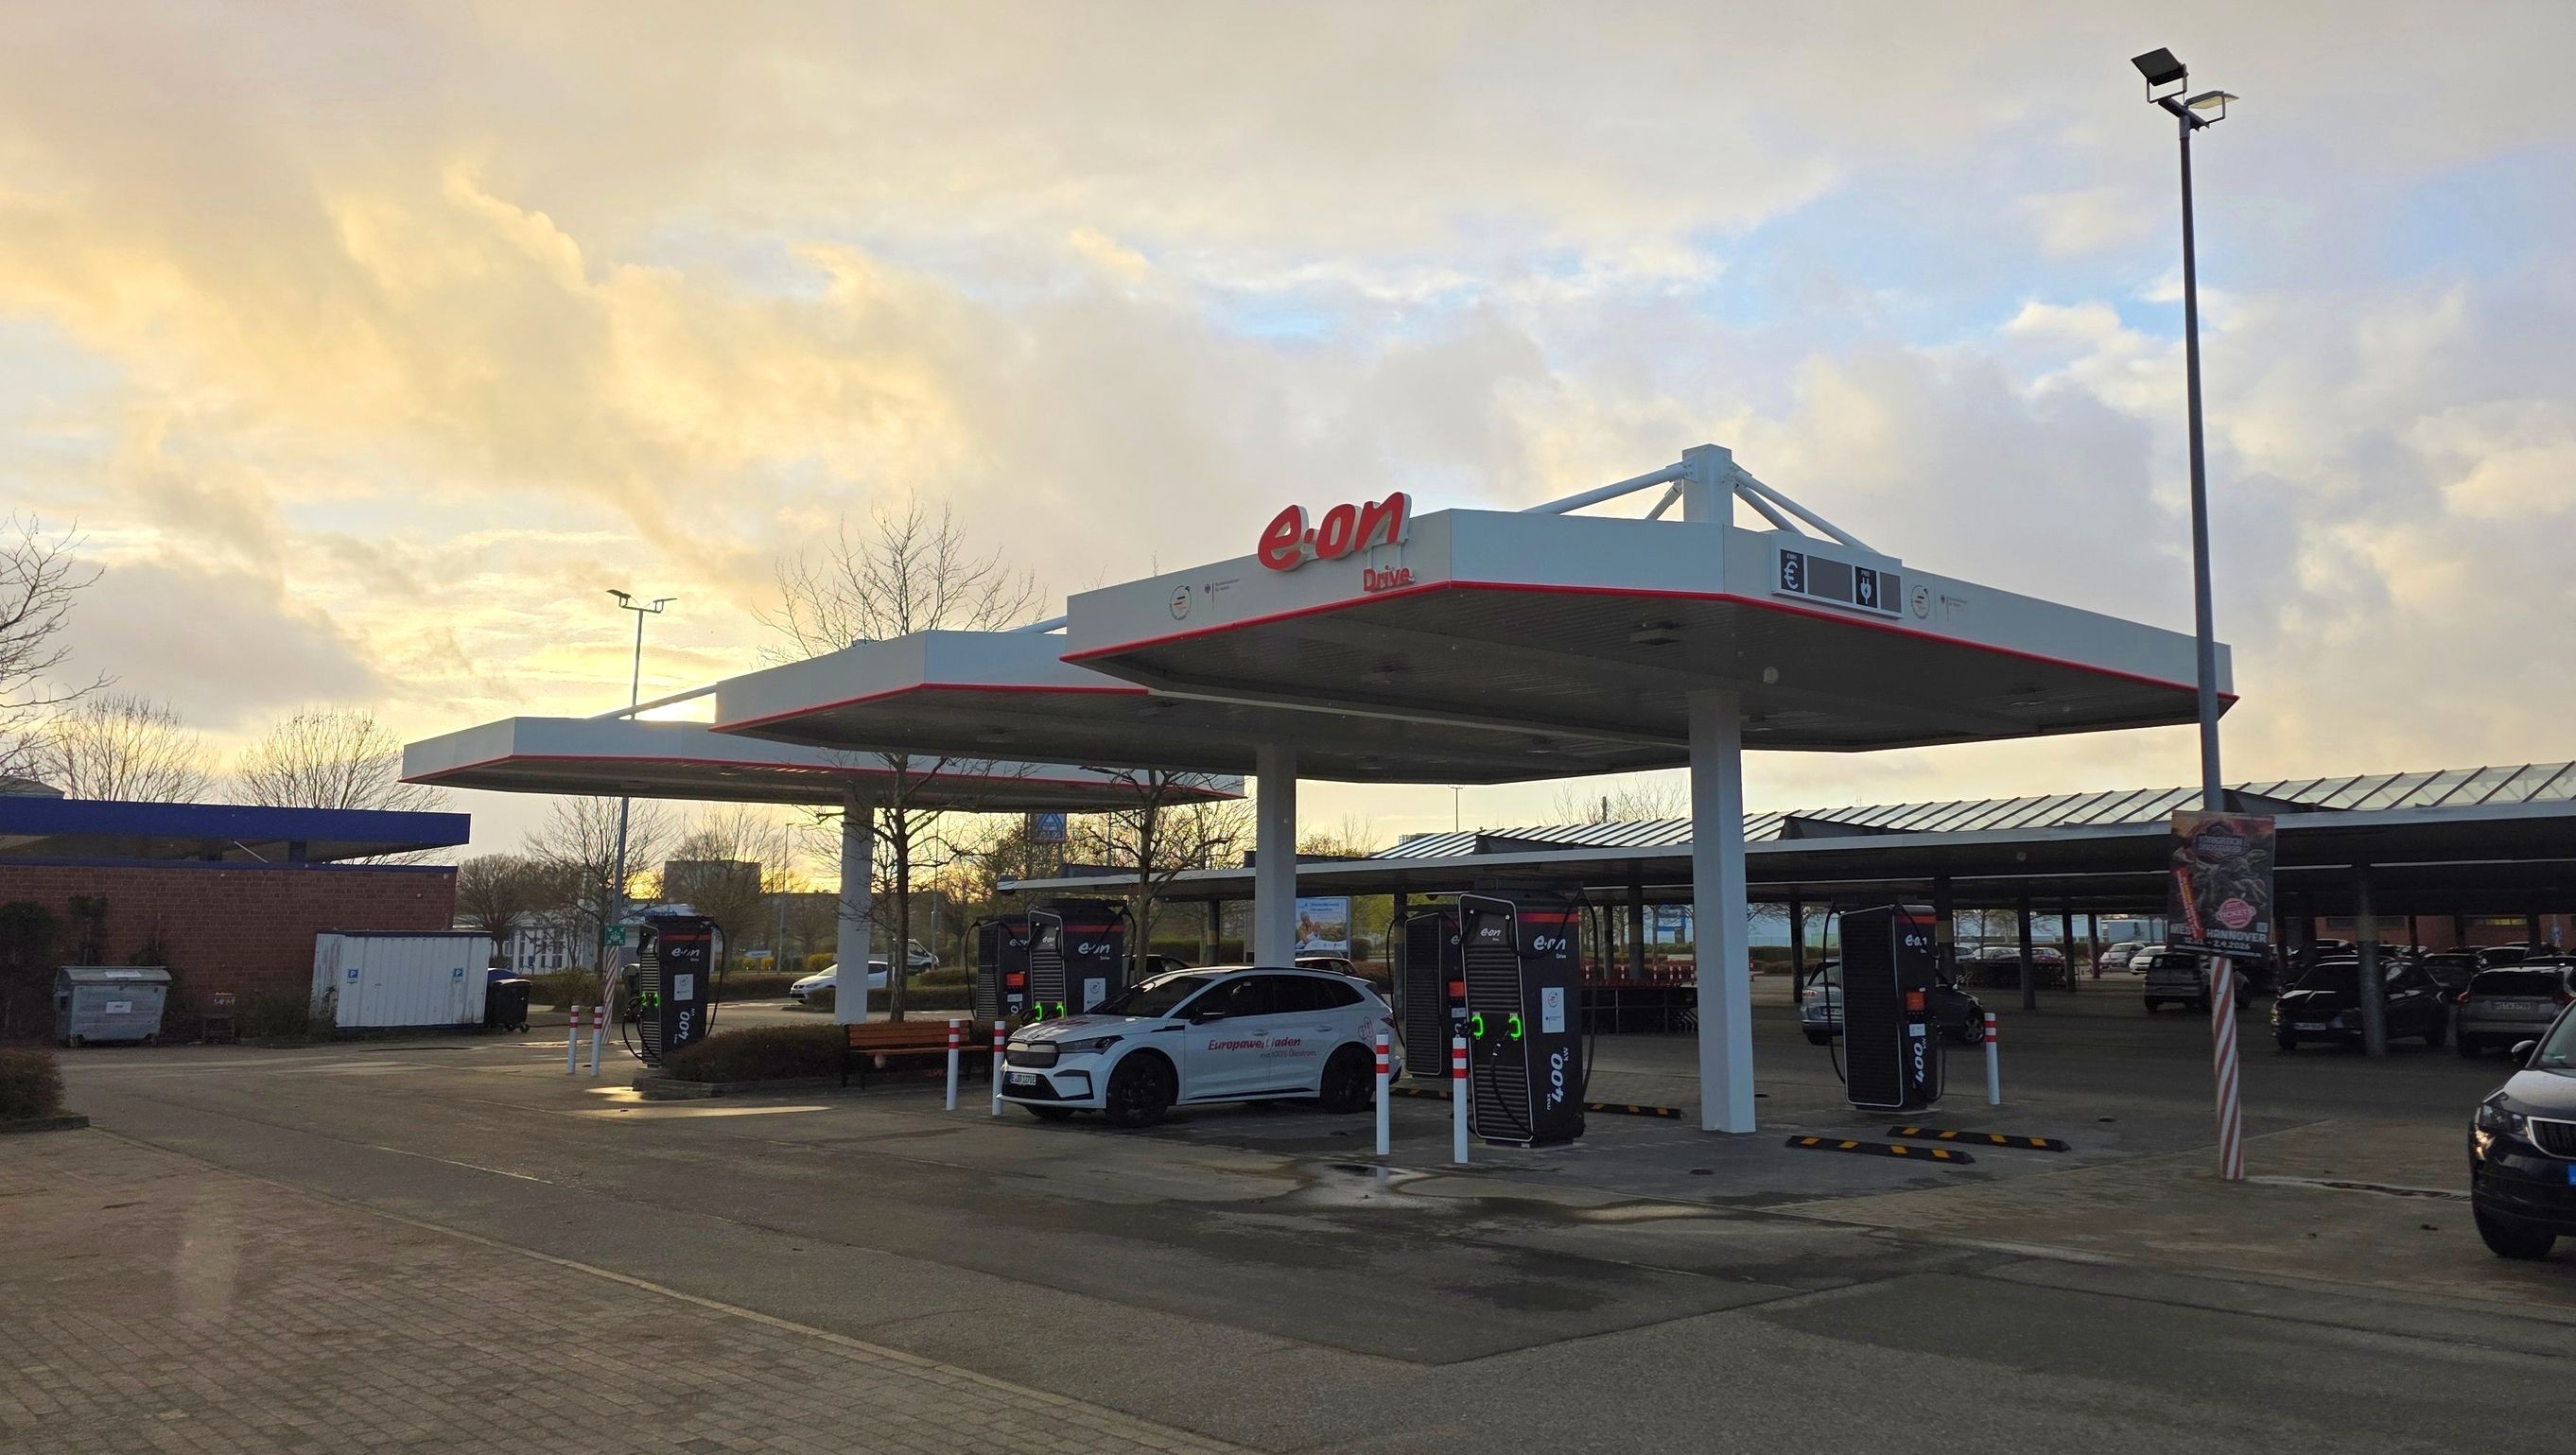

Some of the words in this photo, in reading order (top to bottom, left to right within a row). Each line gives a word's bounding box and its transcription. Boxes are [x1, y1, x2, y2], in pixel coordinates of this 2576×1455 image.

[1363, 564, 1413, 592] Drive
[1784, 561, 1799, 590] €
[2219, 907, 2254, 919] TICKETS
[2206, 927, 2267, 944] HANNOVER
[679, 1011, 690, 1040] 400
[1550, 1052, 1564, 1103] 400
[1562, 1047, 1570, 1062] kW
[1913, 1043, 1924, 1083] 400
